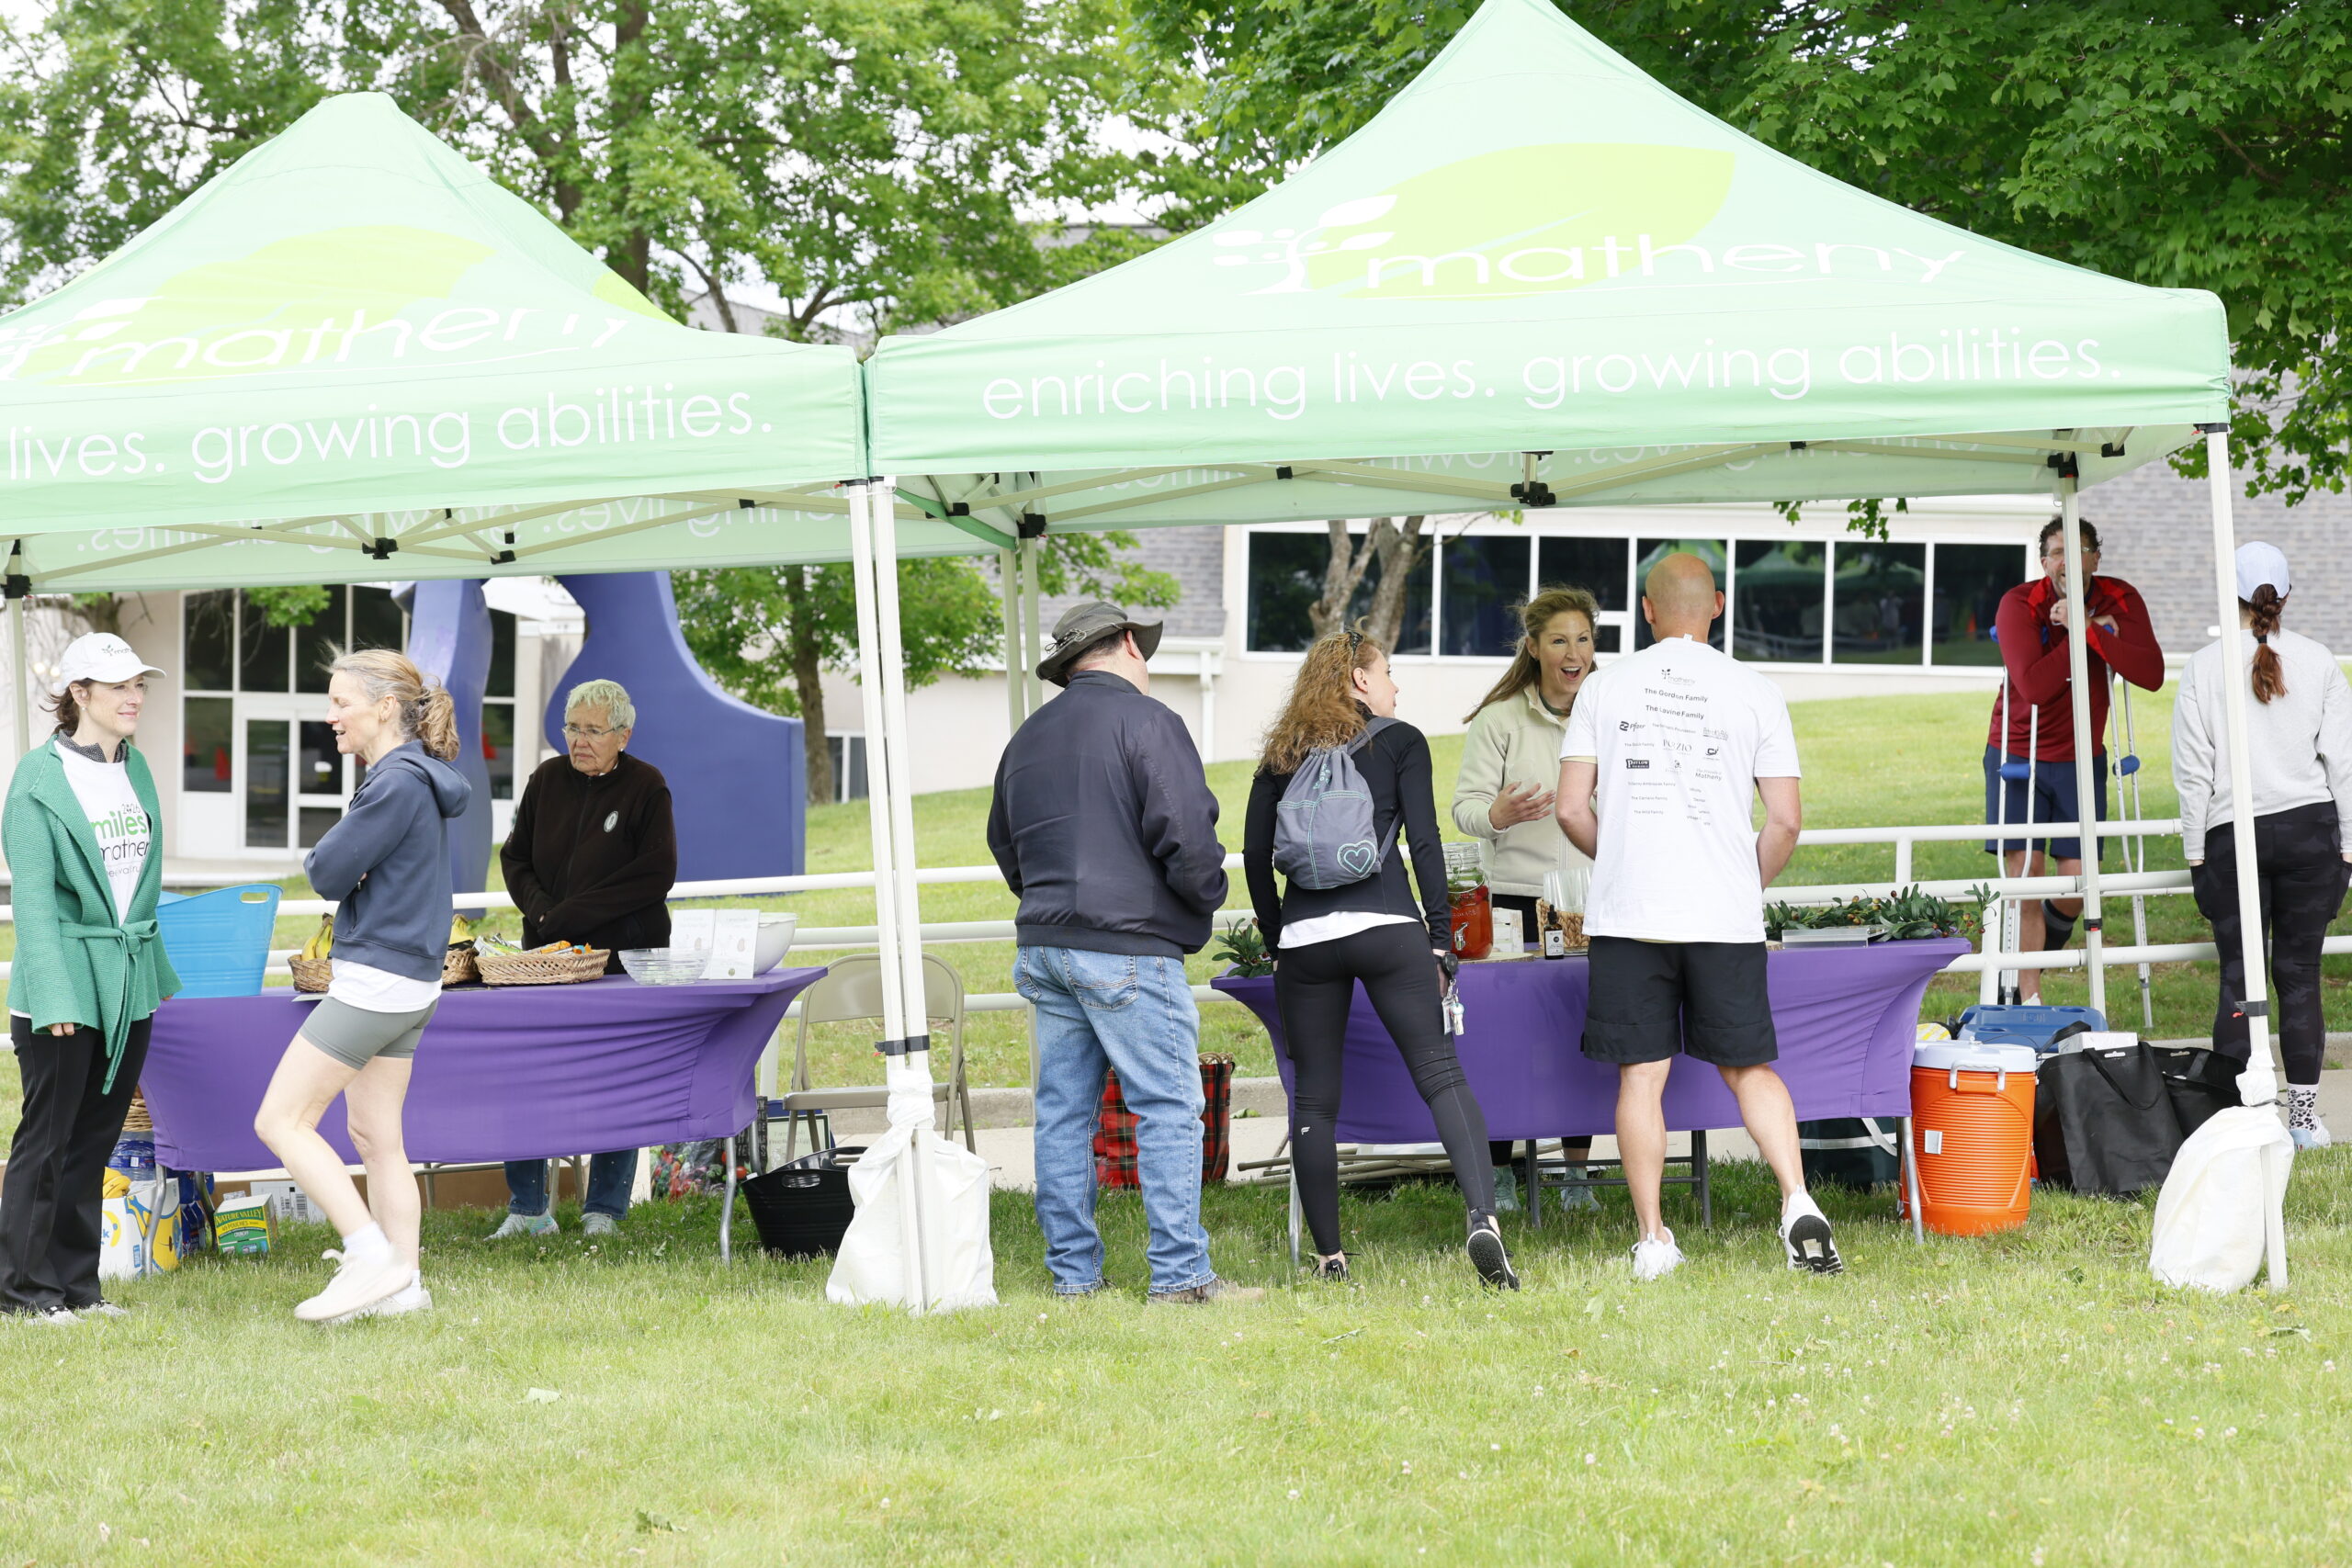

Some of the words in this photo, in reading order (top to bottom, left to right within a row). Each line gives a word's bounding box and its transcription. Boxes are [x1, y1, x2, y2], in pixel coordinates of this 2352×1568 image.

[1367, 235, 1965, 289] matheny
[68, 297, 628, 377] matheny
[982, 356, 1306, 421] enriching
[1333, 351, 1497, 404] lives.
[1522, 337, 1810, 410] growing
[1837, 327, 2124, 385] abilities.
[9, 426, 167, 482] lives.
[190, 402, 470, 484] growing
[496, 383, 774, 451] abilities.
[1658, 690, 1684, 700] Gordon
[1685, 694, 1708, 703] Family
[1680, 710, 1705, 720] Family
[90, 811, 148, 839] miles
[215, 1212, 240, 1225] NATURE
[240, 1208, 263, 1220] VALLEY
